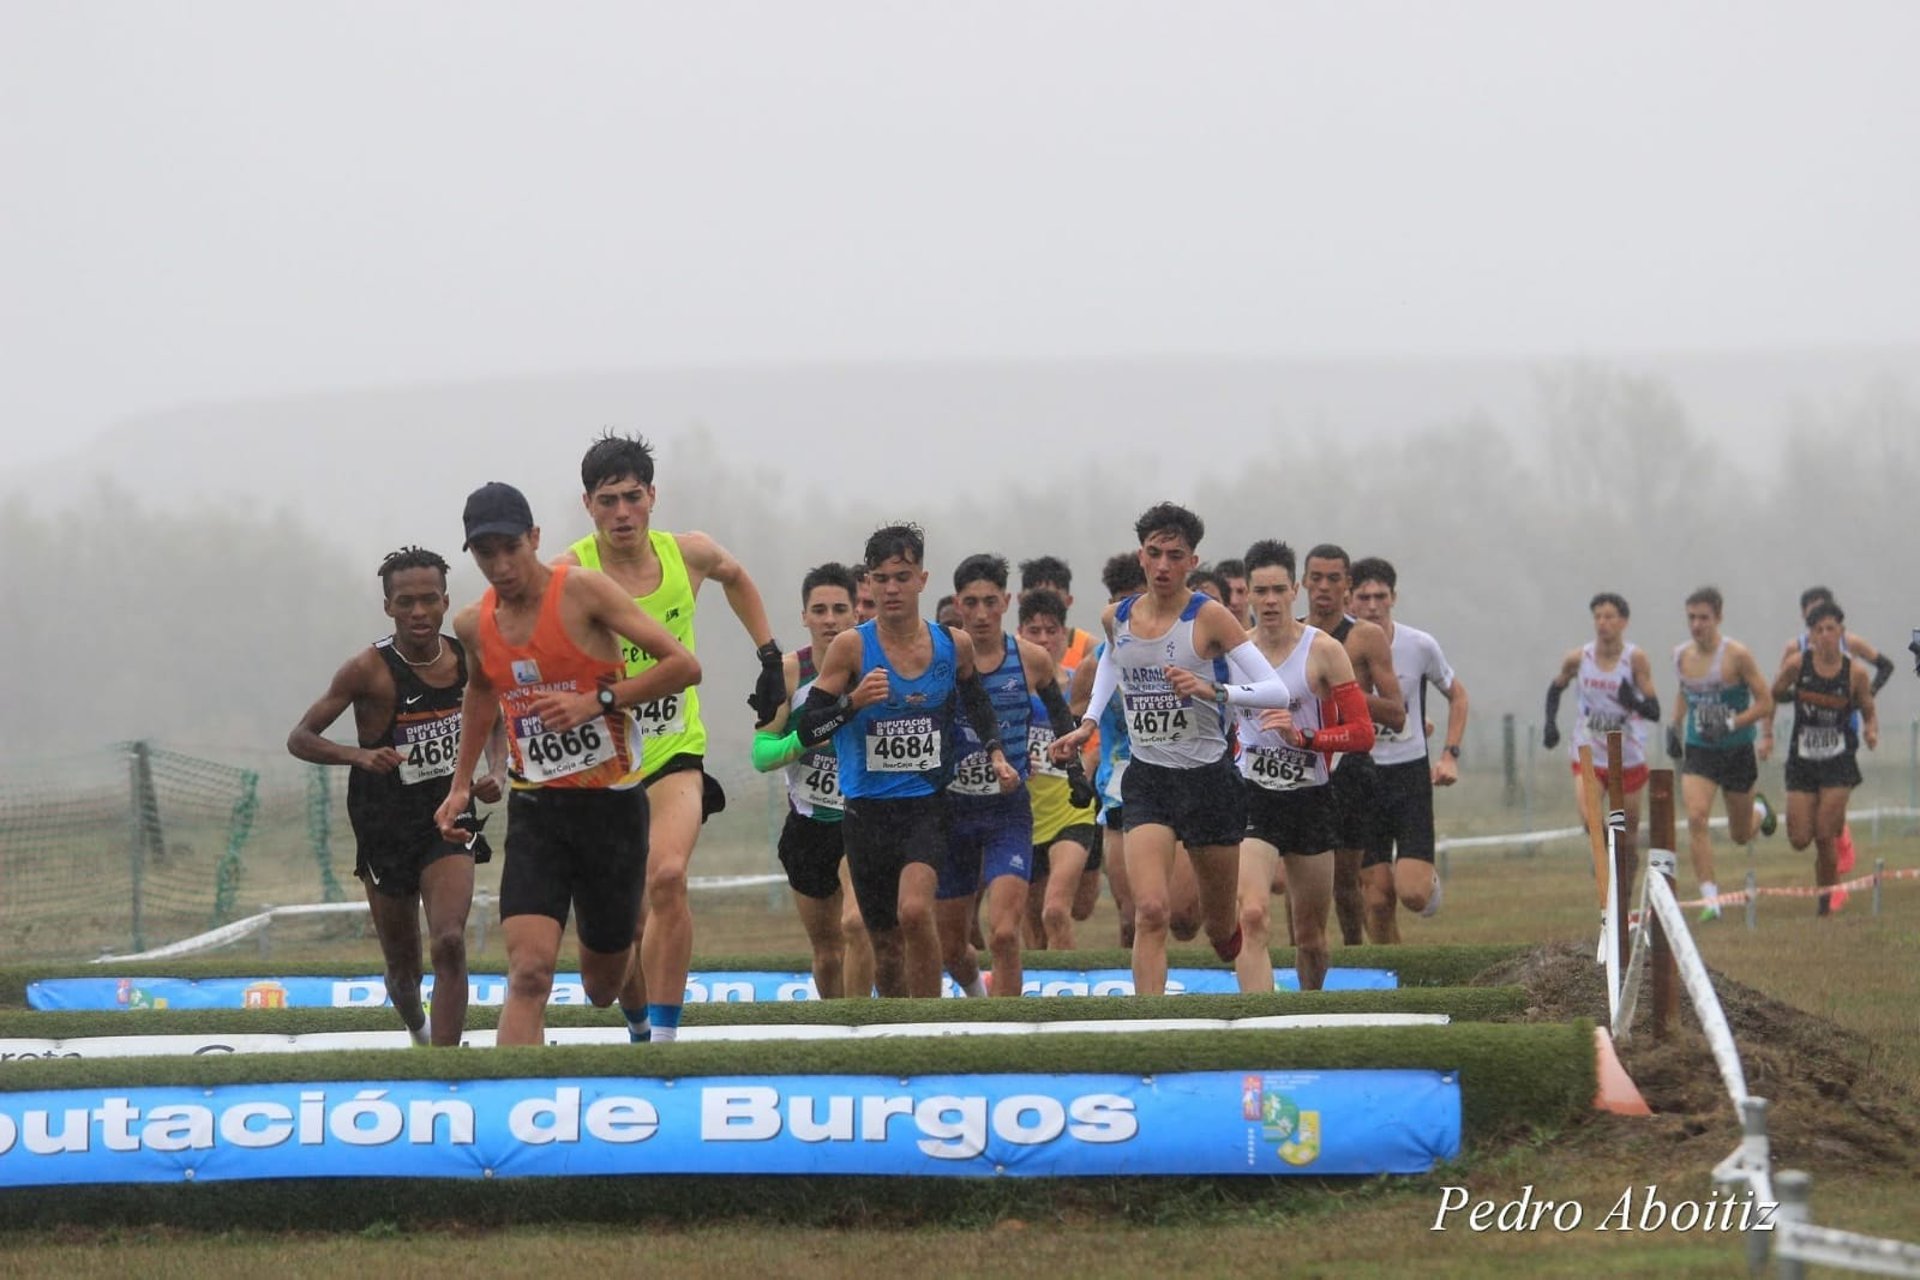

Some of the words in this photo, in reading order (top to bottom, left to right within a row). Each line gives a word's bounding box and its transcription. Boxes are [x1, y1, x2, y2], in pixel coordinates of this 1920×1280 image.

[1133, 709, 1188, 734] 4674
[528, 724, 601, 765] 4666
[875, 733, 935, 759] 4684
[1252, 756, 1308, 783] 4662
[508, 1086, 660, 1144] de
[700, 1086, 1139, 1160] Burgos
